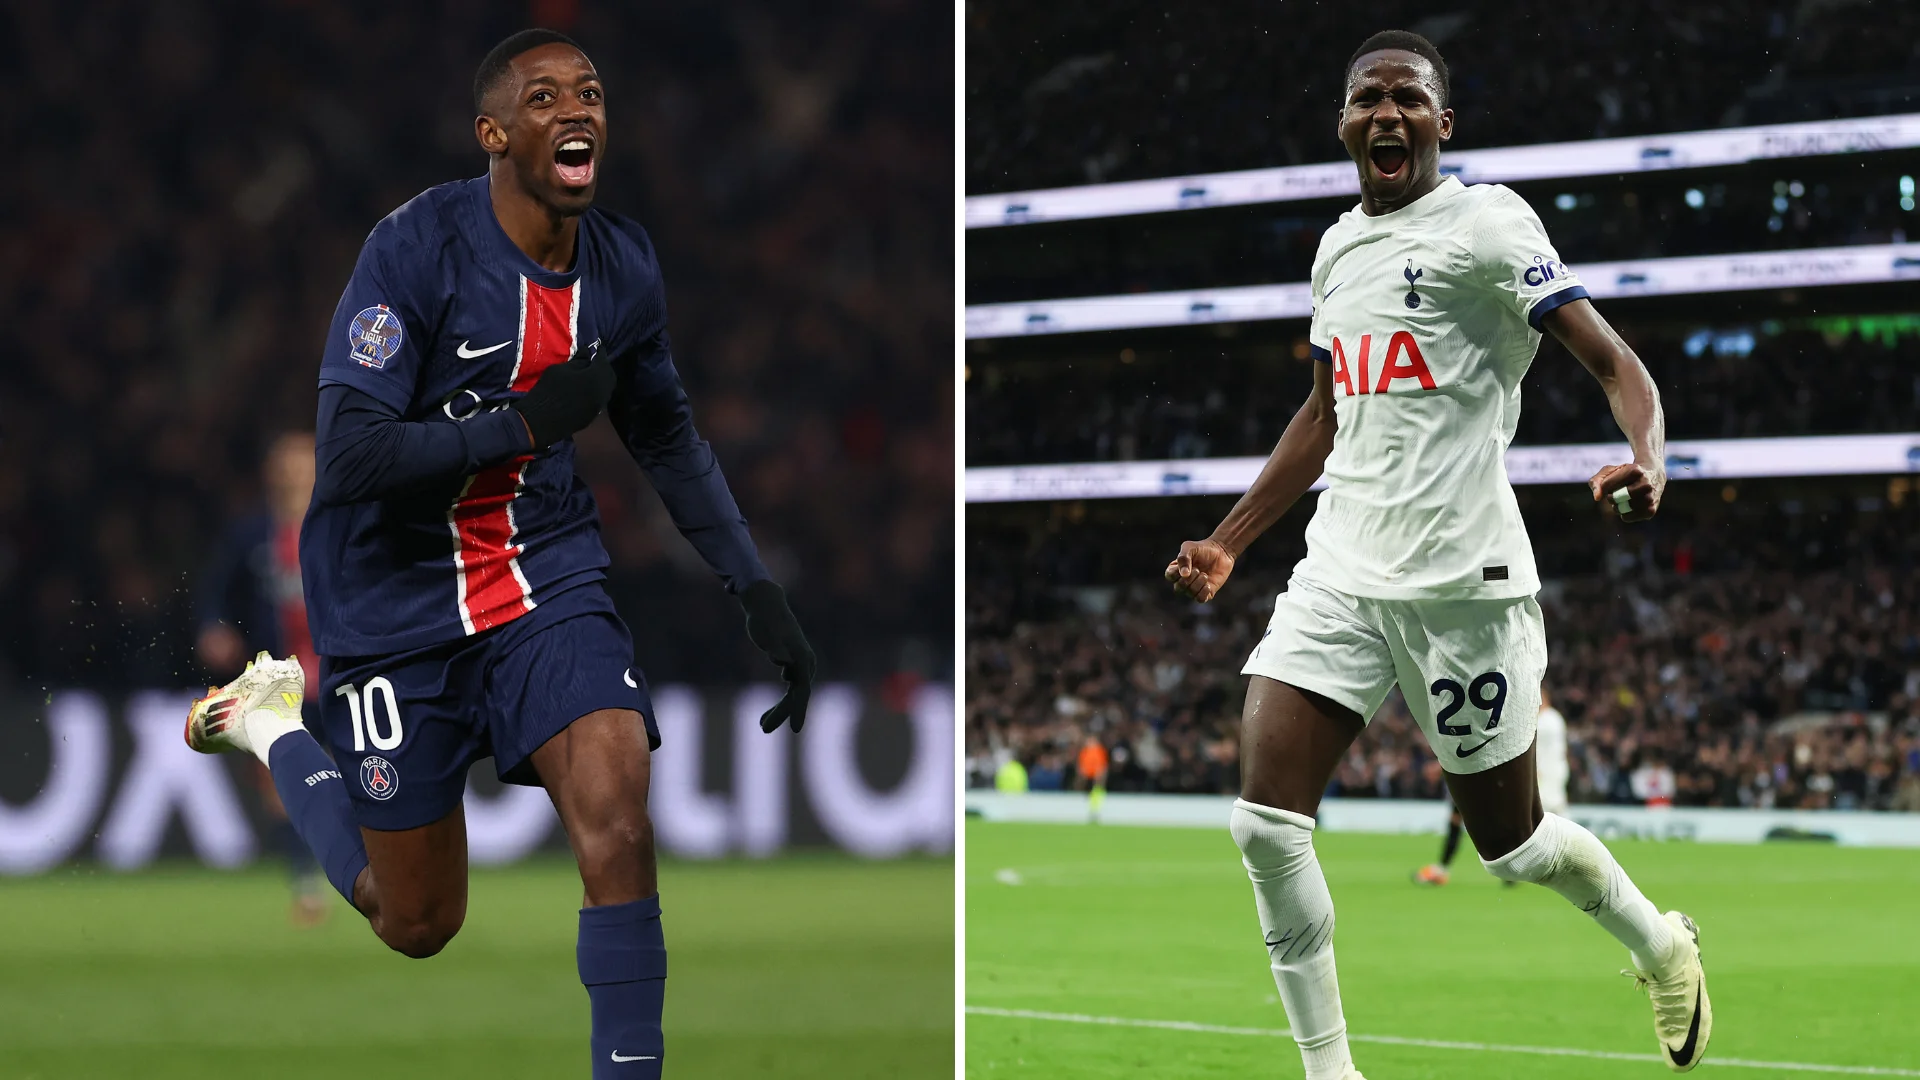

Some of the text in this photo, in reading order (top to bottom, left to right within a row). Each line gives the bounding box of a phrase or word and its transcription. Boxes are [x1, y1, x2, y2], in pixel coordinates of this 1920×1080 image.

[1332, 330, 1438, 396] AIA
[335, 676, 404, 752] 10
[1431, 672, 1507, 736] 29
[364, 758, 388, 769] PARIS
